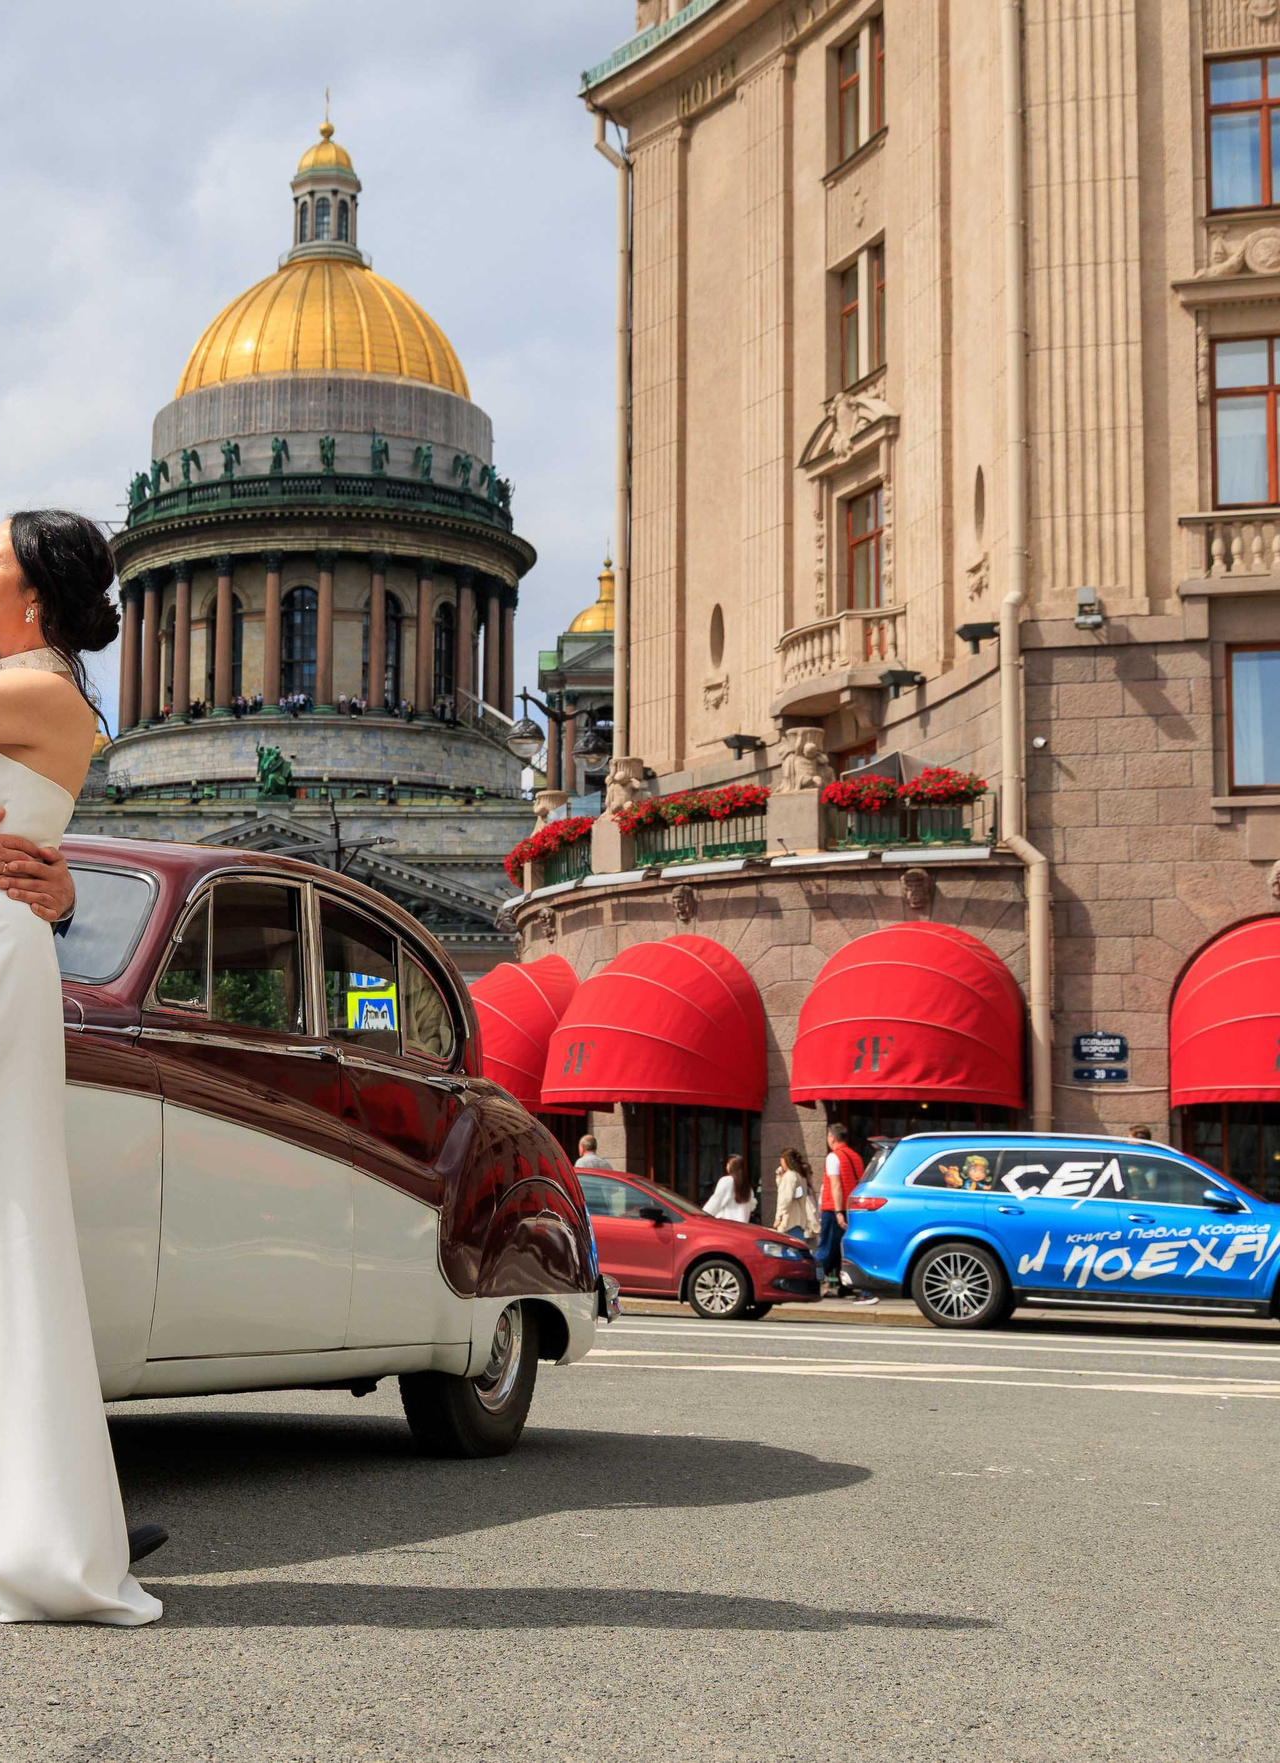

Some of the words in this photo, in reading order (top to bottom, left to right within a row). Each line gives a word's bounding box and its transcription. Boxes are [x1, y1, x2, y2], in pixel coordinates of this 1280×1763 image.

[1001, 1157, 1124, 1210] СЕЛ
[1066, 1230, 1122, 1244] книга
[1127, 1226, 1192, 1240] Павла
